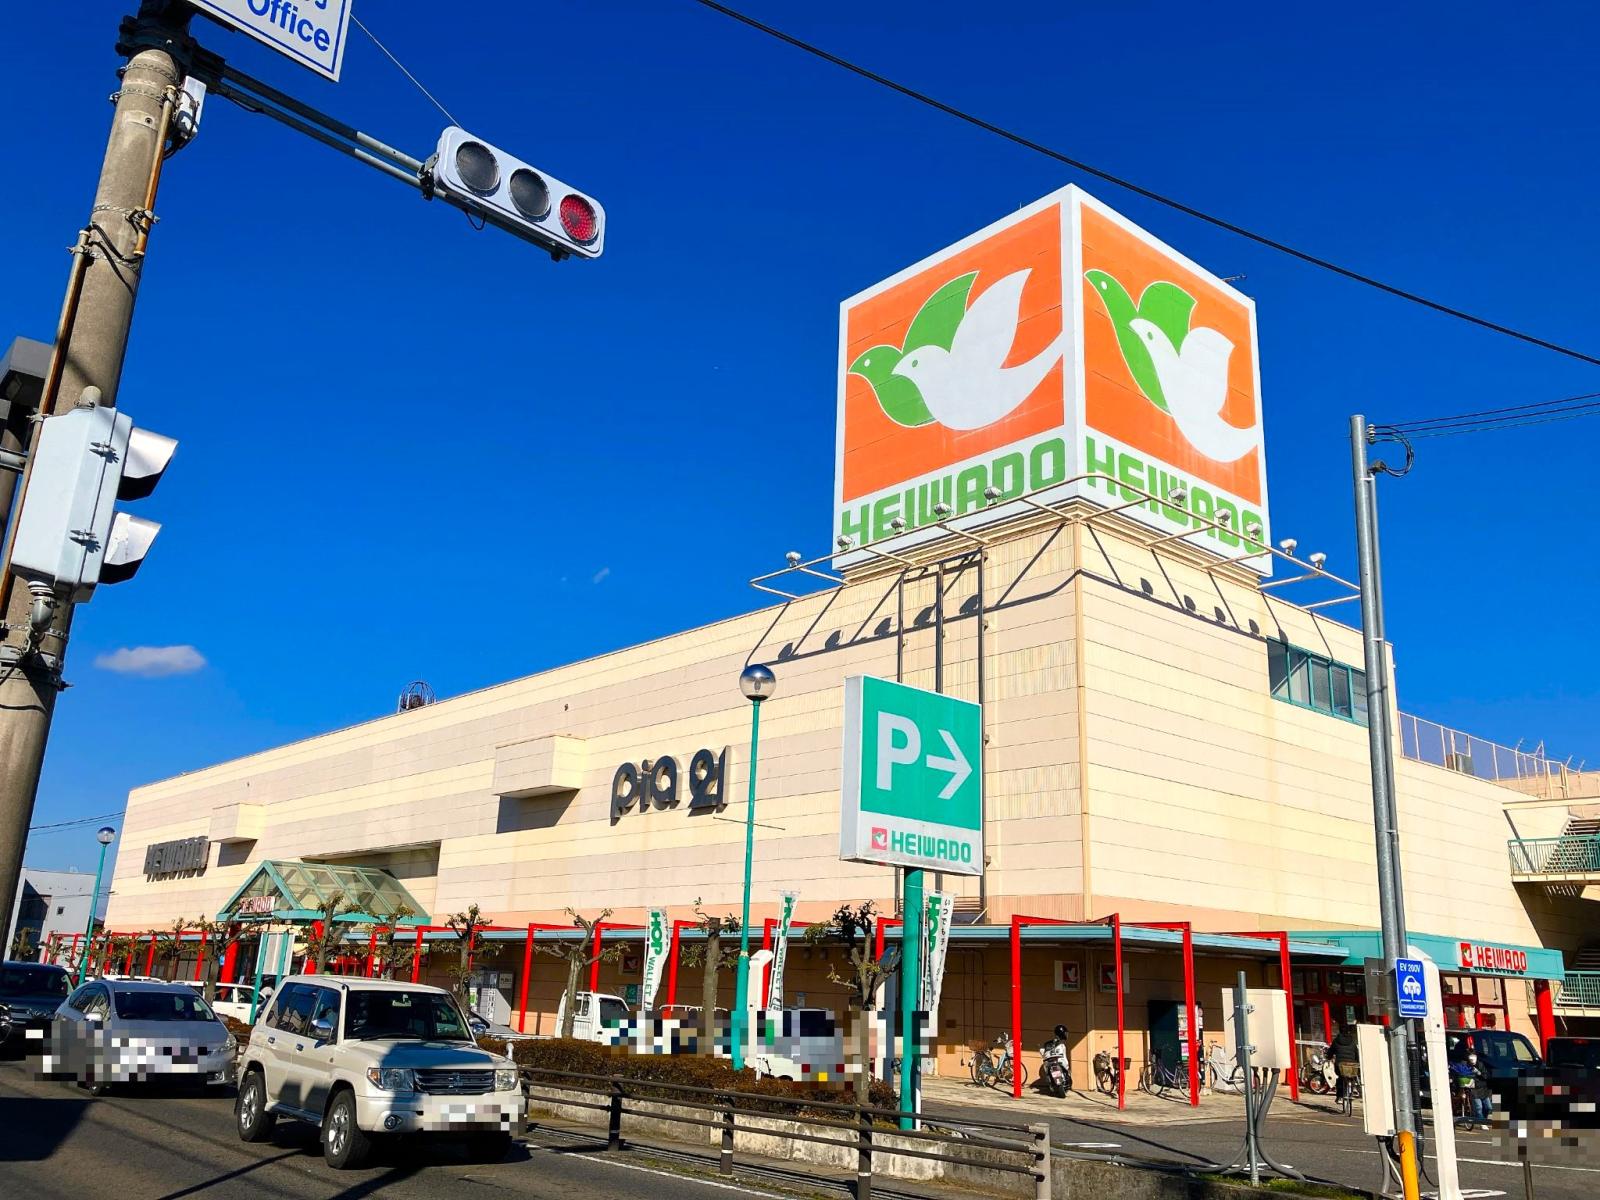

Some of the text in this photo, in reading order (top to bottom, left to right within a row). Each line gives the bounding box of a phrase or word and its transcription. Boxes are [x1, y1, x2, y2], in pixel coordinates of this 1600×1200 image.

[247, 0, 330, 51] Office
[842, 437, 1066, 547] HEIWADO
[1086, 435, 1265, 558] HEIWADO
[876, 711, 921, 791] P
[610, 745, 730, 823] pia 21
[891, 831, 972, 863] HEIWADO
[650, 911, 663, 955] HOP
[644, 956, 656, 997] WALLET
[1400, 963, 1420, 973] EV 200V
[1476, 945, 1527, 971] HEIWADO
